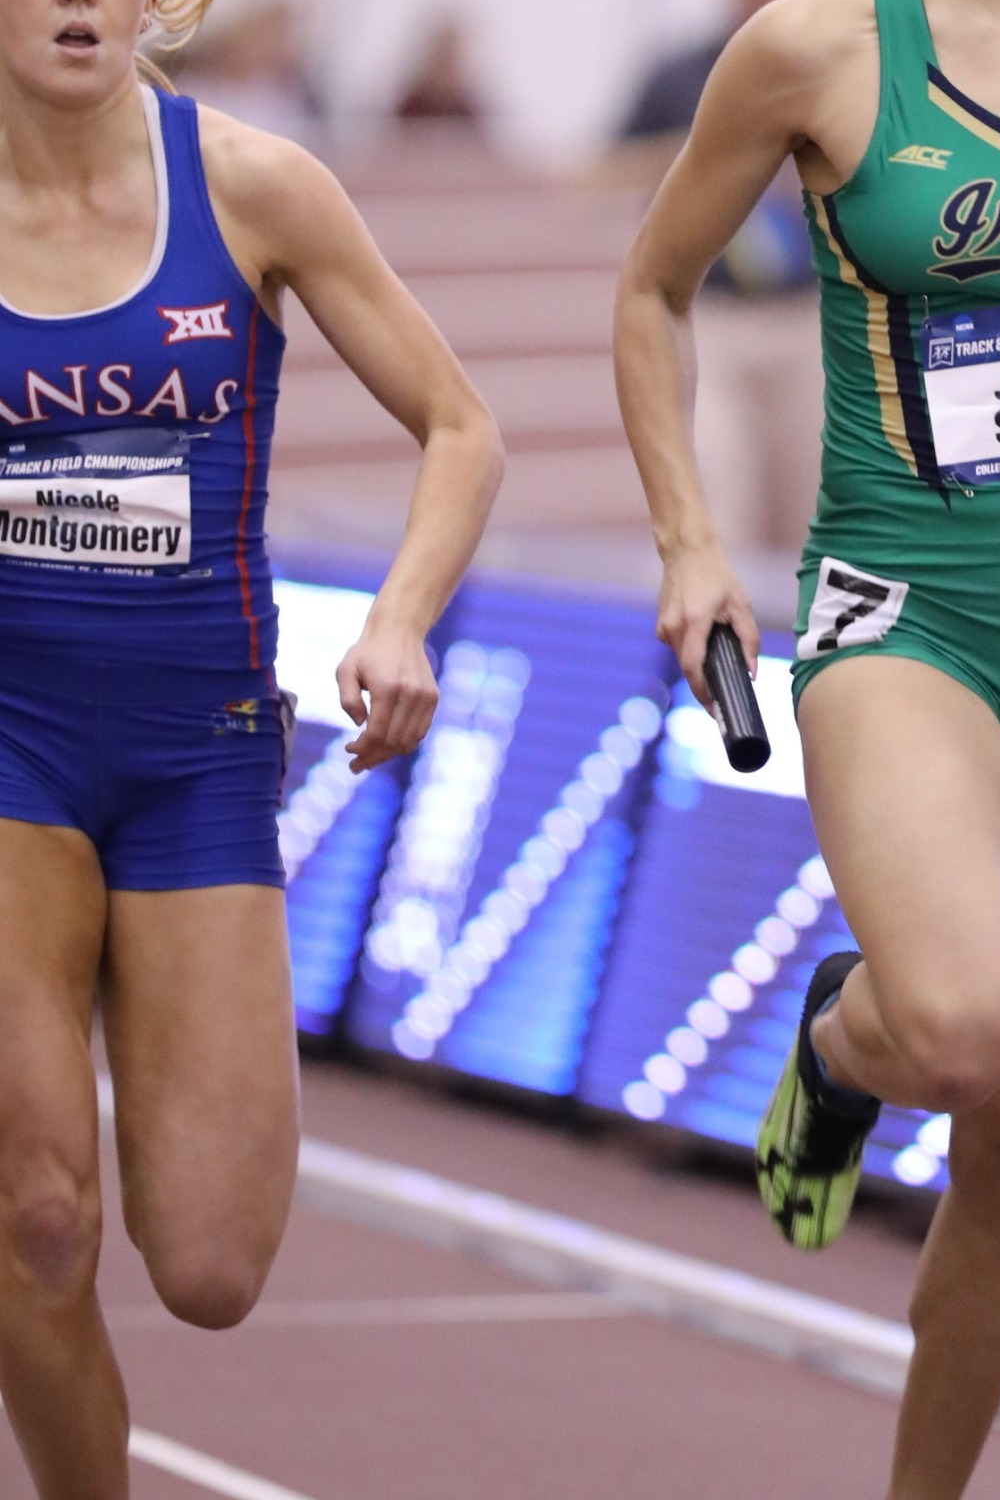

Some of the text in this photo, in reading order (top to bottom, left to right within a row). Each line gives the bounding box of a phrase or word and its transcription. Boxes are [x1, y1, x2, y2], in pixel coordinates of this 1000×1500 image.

[890, 145, 953, 169] ACC
[160, 302, 234, 345] XII
[956, 338, 994, 357] TRACK
[5, 461, 42, 475] TRACK
[51, 455, 82, 472] FIELD
[83, 455, 184, 471] CHAMPIONSHIPS
[36, 490, 120, 512] Nicole
[817, 568, 891, 651] 7
